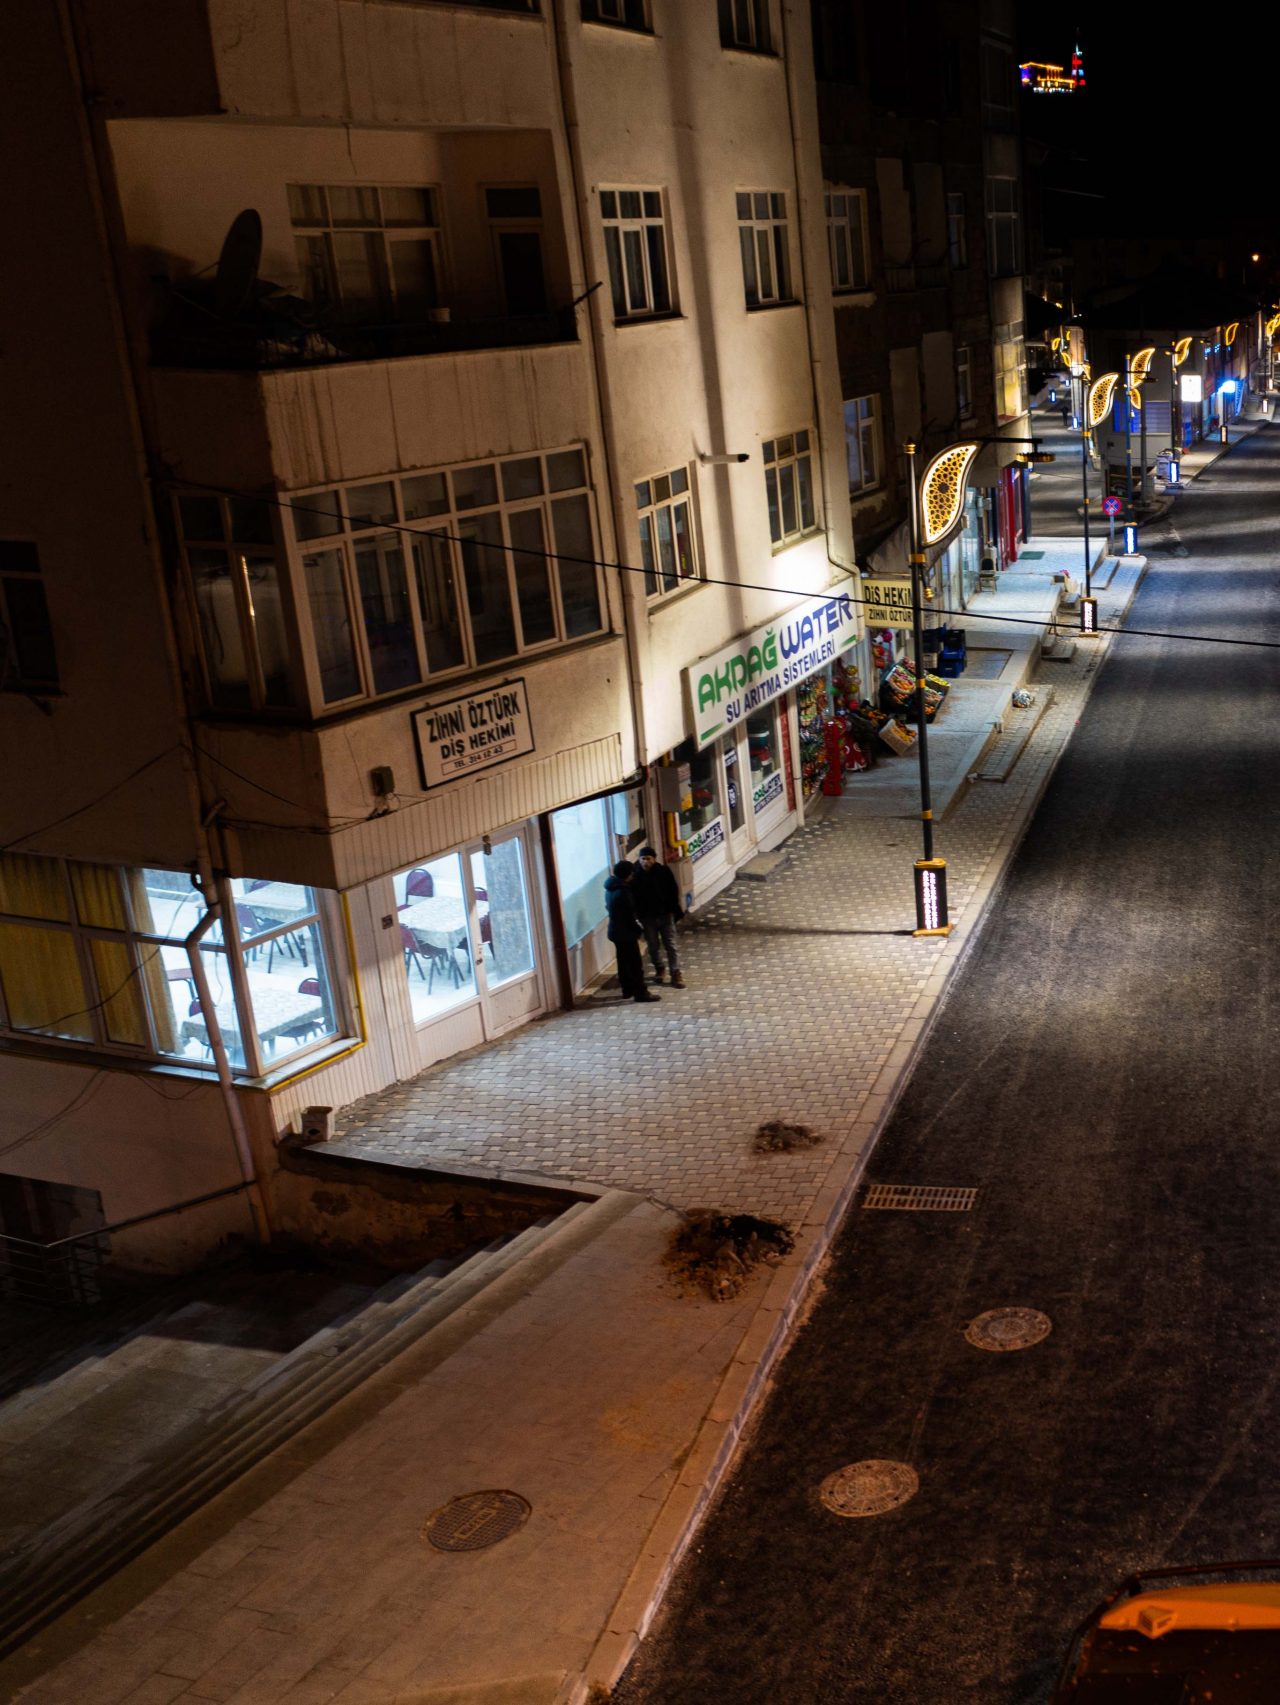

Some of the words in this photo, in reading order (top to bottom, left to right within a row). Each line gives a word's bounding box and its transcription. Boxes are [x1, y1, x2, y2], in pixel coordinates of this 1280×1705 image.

[889, 607, 912, 622] ÖZTÜR
[697, 627, 779, 713] AKDAĞ
[779, 592, 854, 660] WATER
[726, 698, 741, 723] SU
[744, 673, 782, 713] ARITMA
[783, 635, 836, 686] SİSTEMLERİ
[426, 704, 466, 743] ZİHNİ
[468, 692, 520, 729] ÖZTÜRK
[440, 738, 466, 759] DİŞ
[468, 718, 516, 750] HEKİMİ
